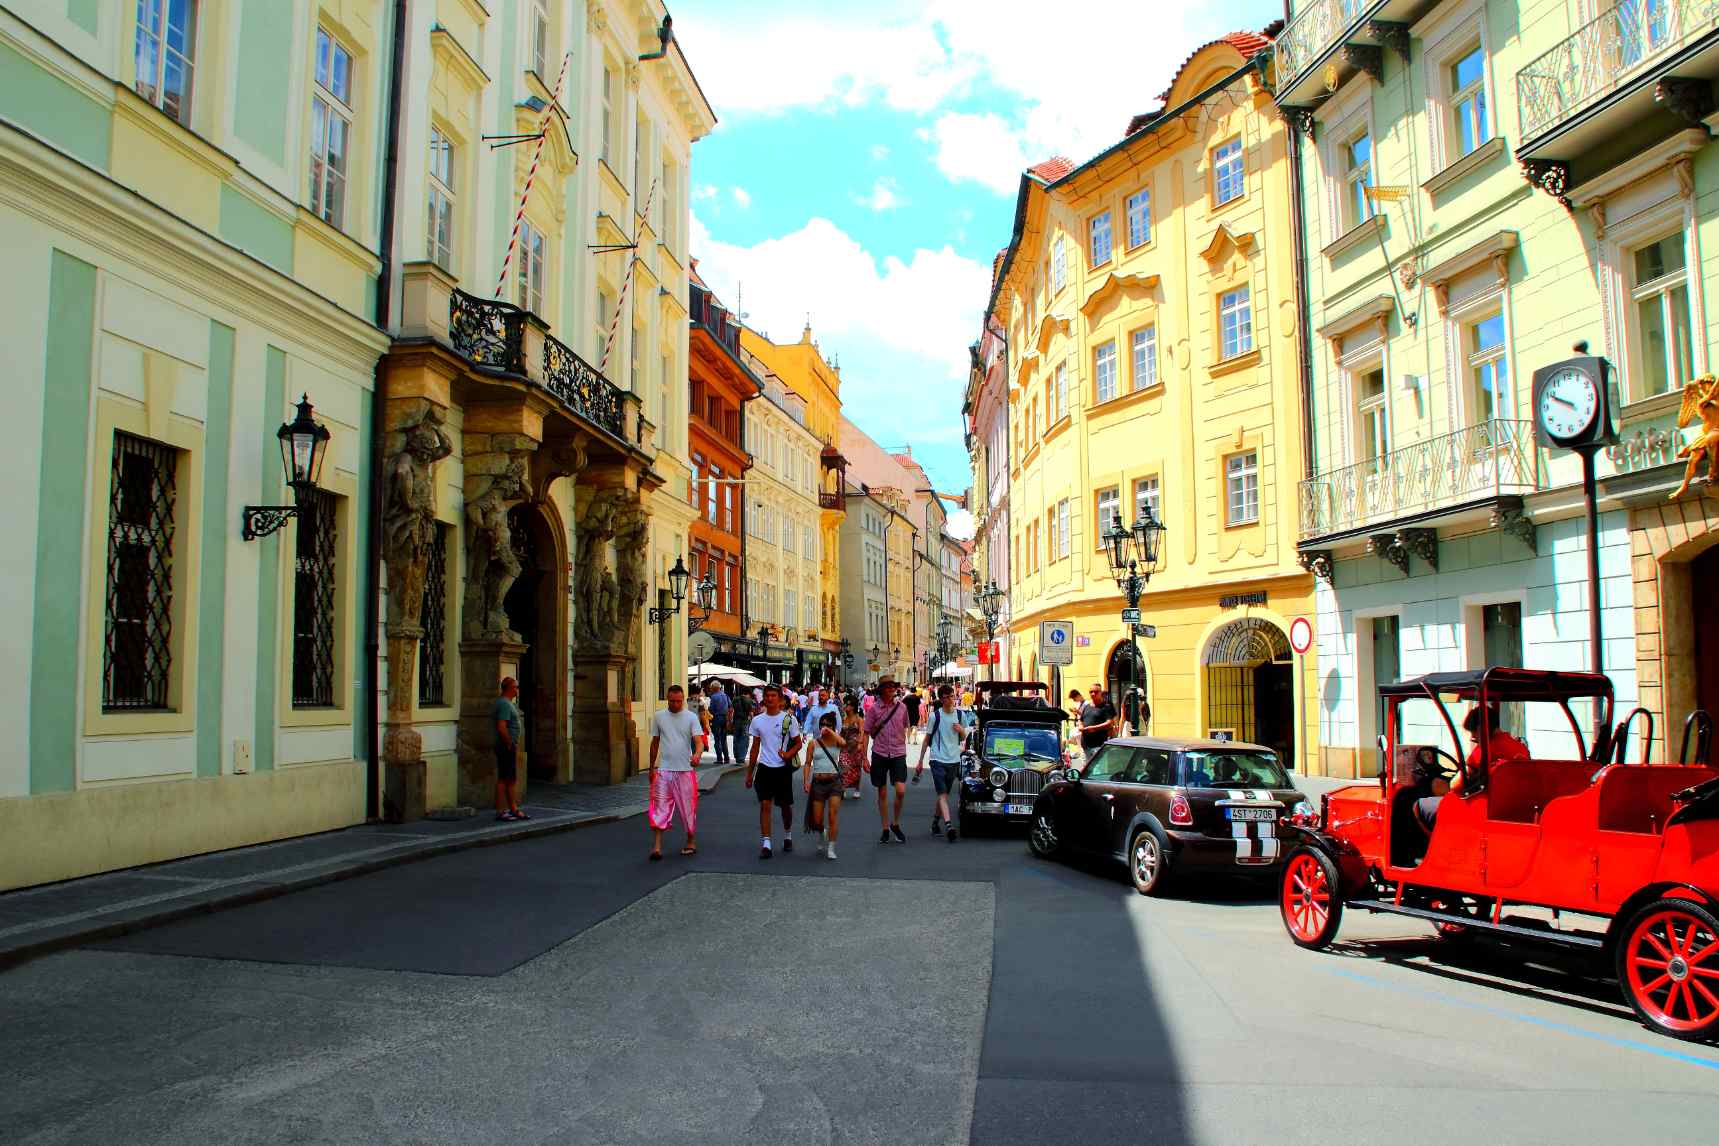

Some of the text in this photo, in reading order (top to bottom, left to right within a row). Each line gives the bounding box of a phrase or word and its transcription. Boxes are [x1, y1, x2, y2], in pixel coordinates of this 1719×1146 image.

[1563, 372, 1572, 381] 12
[1553, 379, 1560, 388] 11
[1232, 808, 1246, 818] 4ST
